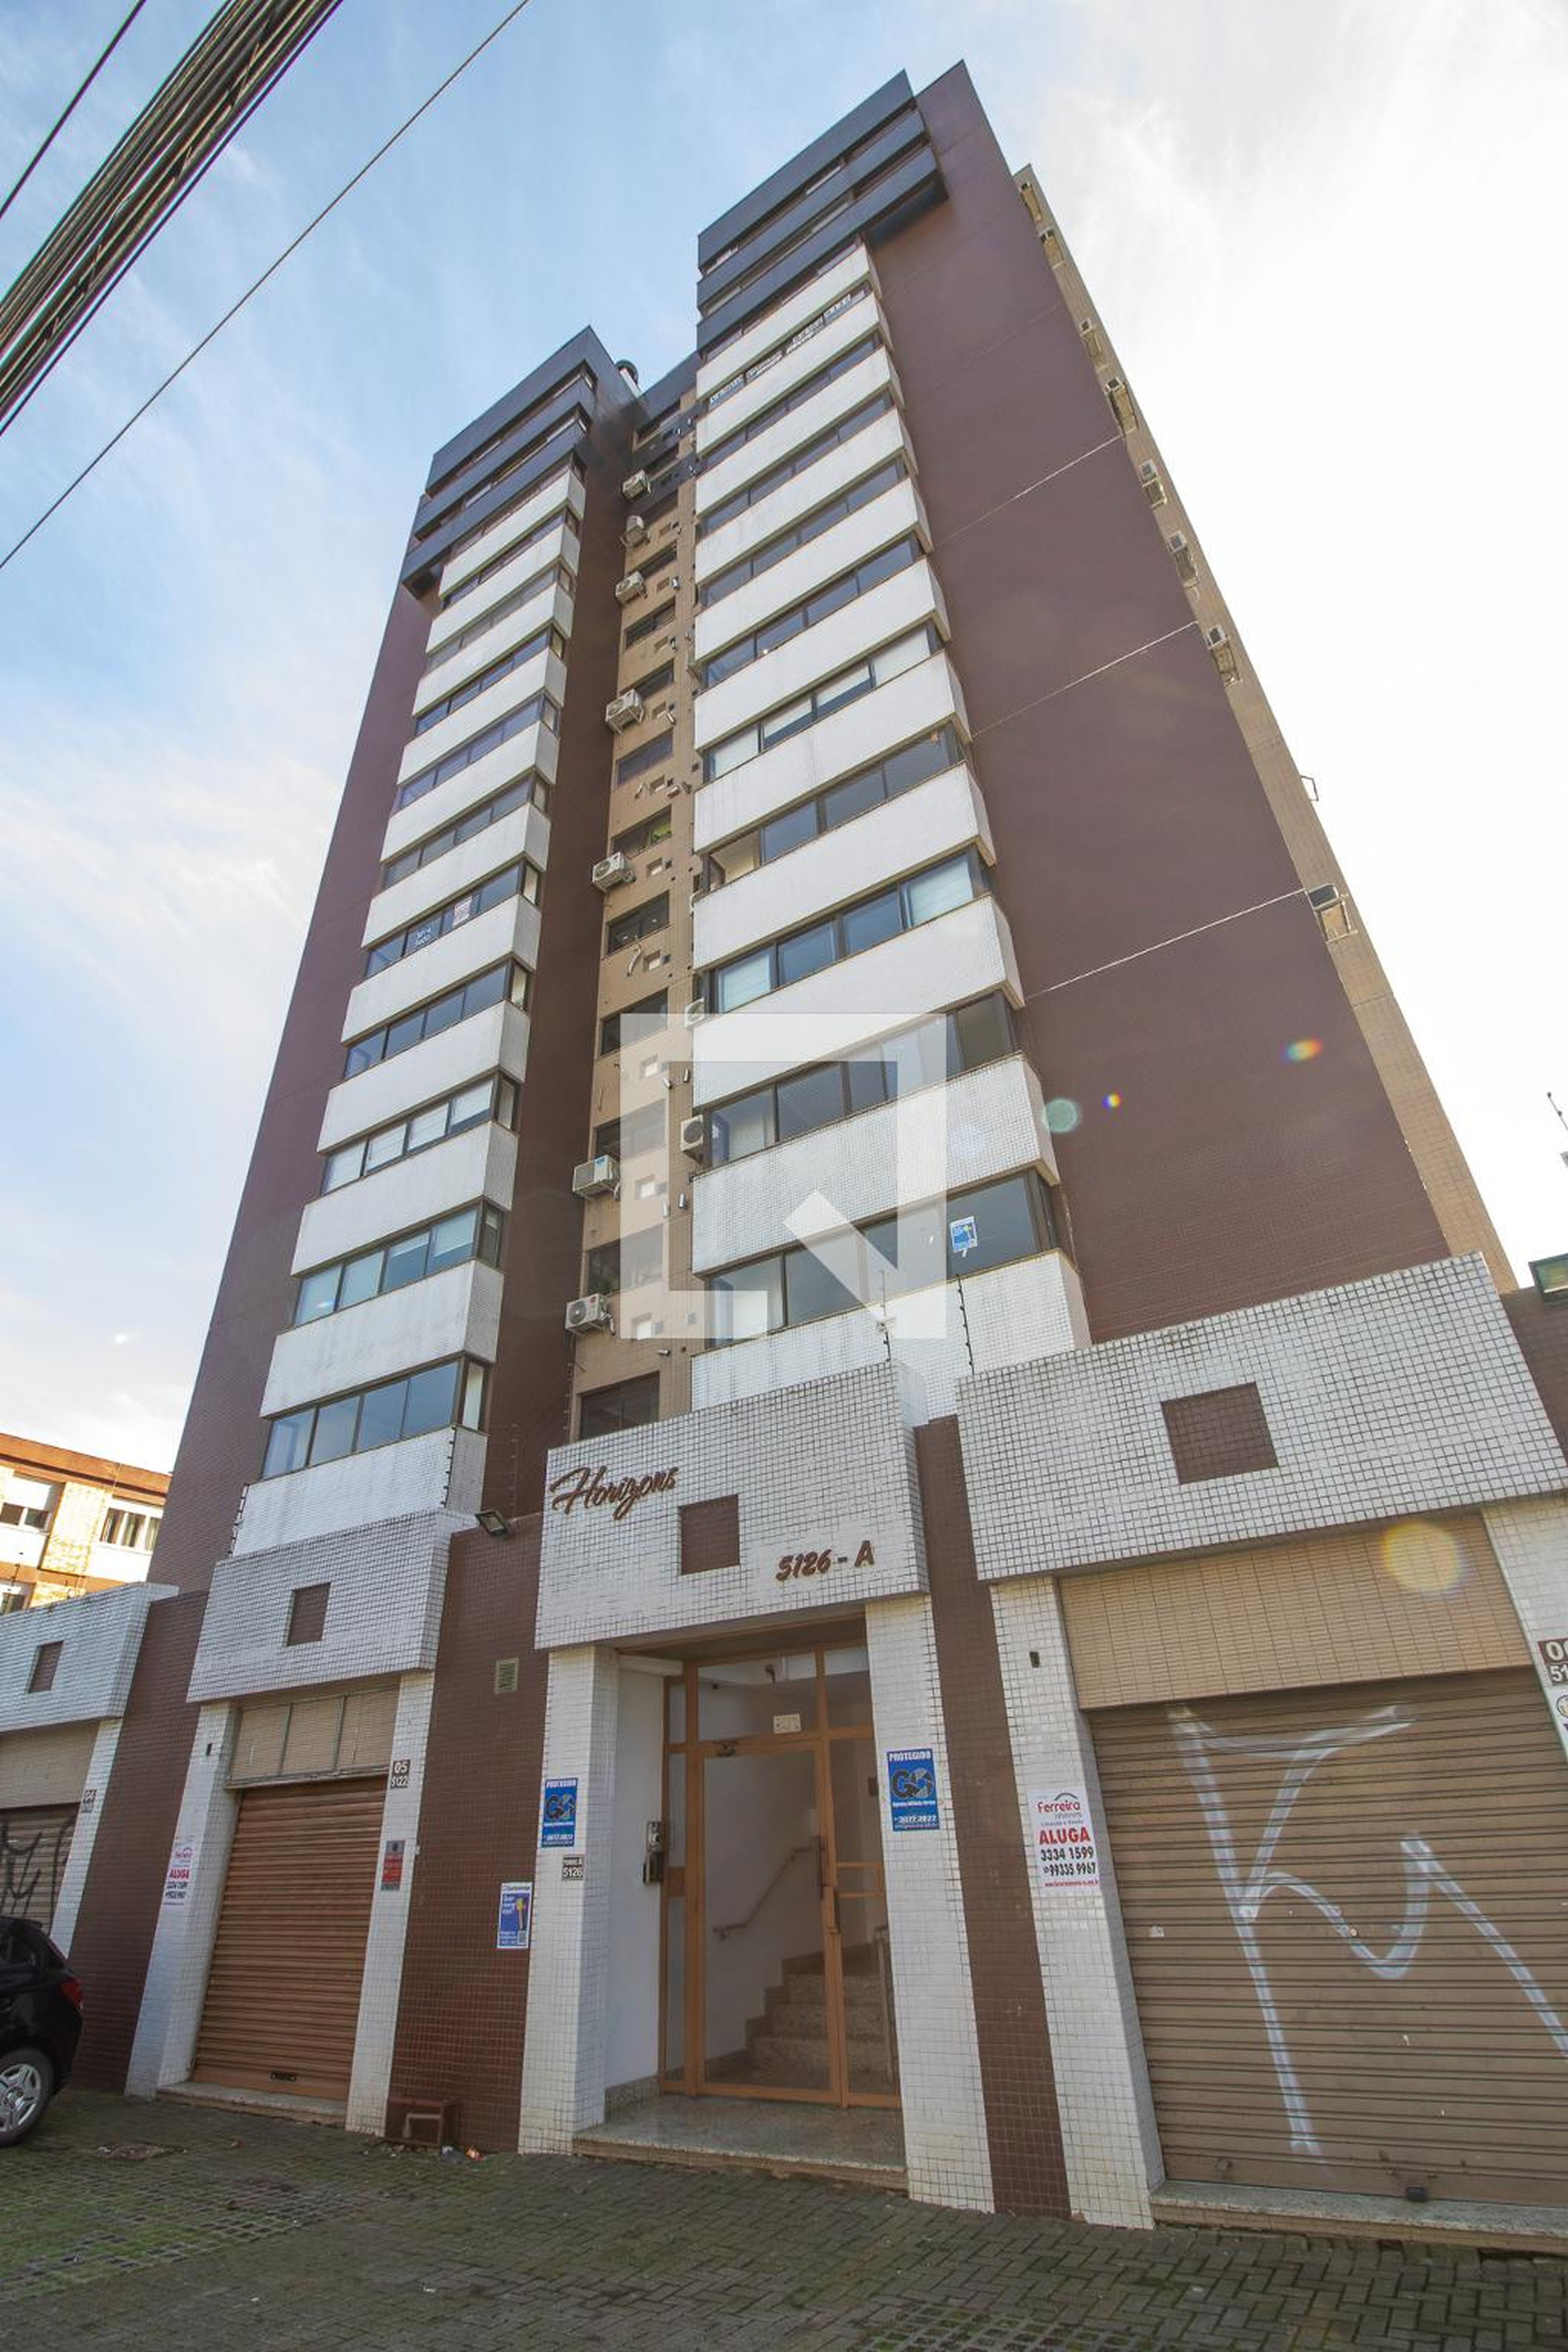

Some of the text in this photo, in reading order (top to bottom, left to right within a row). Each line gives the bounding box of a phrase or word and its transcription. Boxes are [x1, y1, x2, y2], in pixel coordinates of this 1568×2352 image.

[394, 1761, 408, 1774] 05
[1039, 1826, 1091, 1845] ALUGA
[1041, 1846, 1094, 1861] 3334 1599
